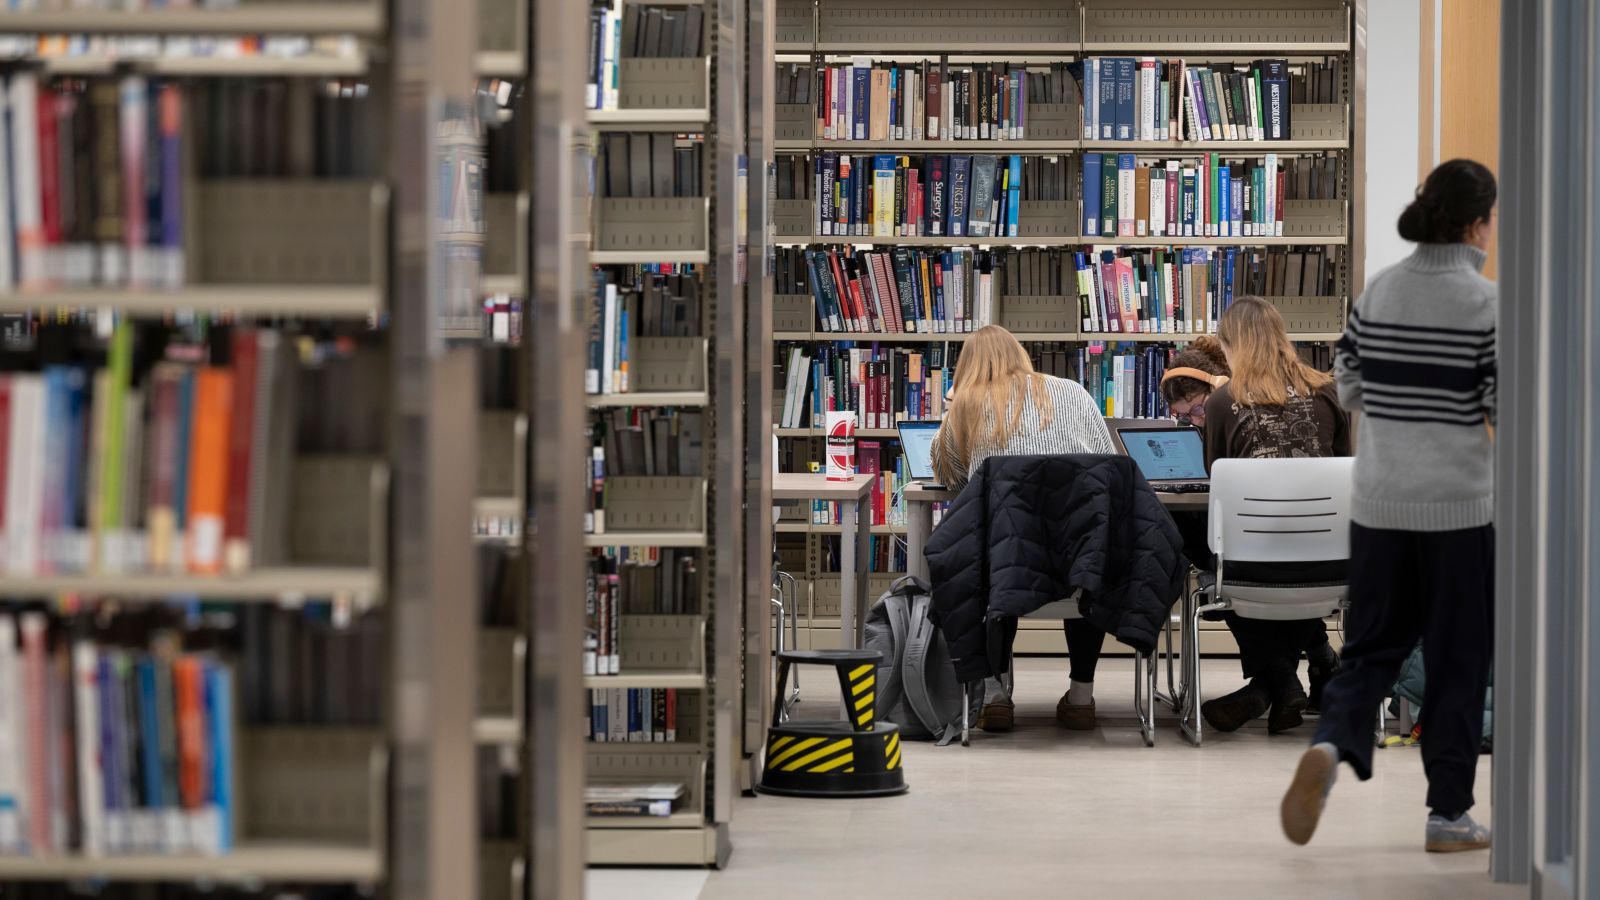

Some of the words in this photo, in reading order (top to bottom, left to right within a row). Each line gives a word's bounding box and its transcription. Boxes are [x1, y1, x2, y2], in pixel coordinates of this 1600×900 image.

[1271, 84, 1280, 126] ANESTHESIOLOGY
[822, 193, 830, 218] Surgery
[934, 181, 944, 218] Surgery
[954, 173, 964, 219] SURGERY
[976, 174, 985, 207] SURGERY
[586, 579, 595, 614] CANCER
